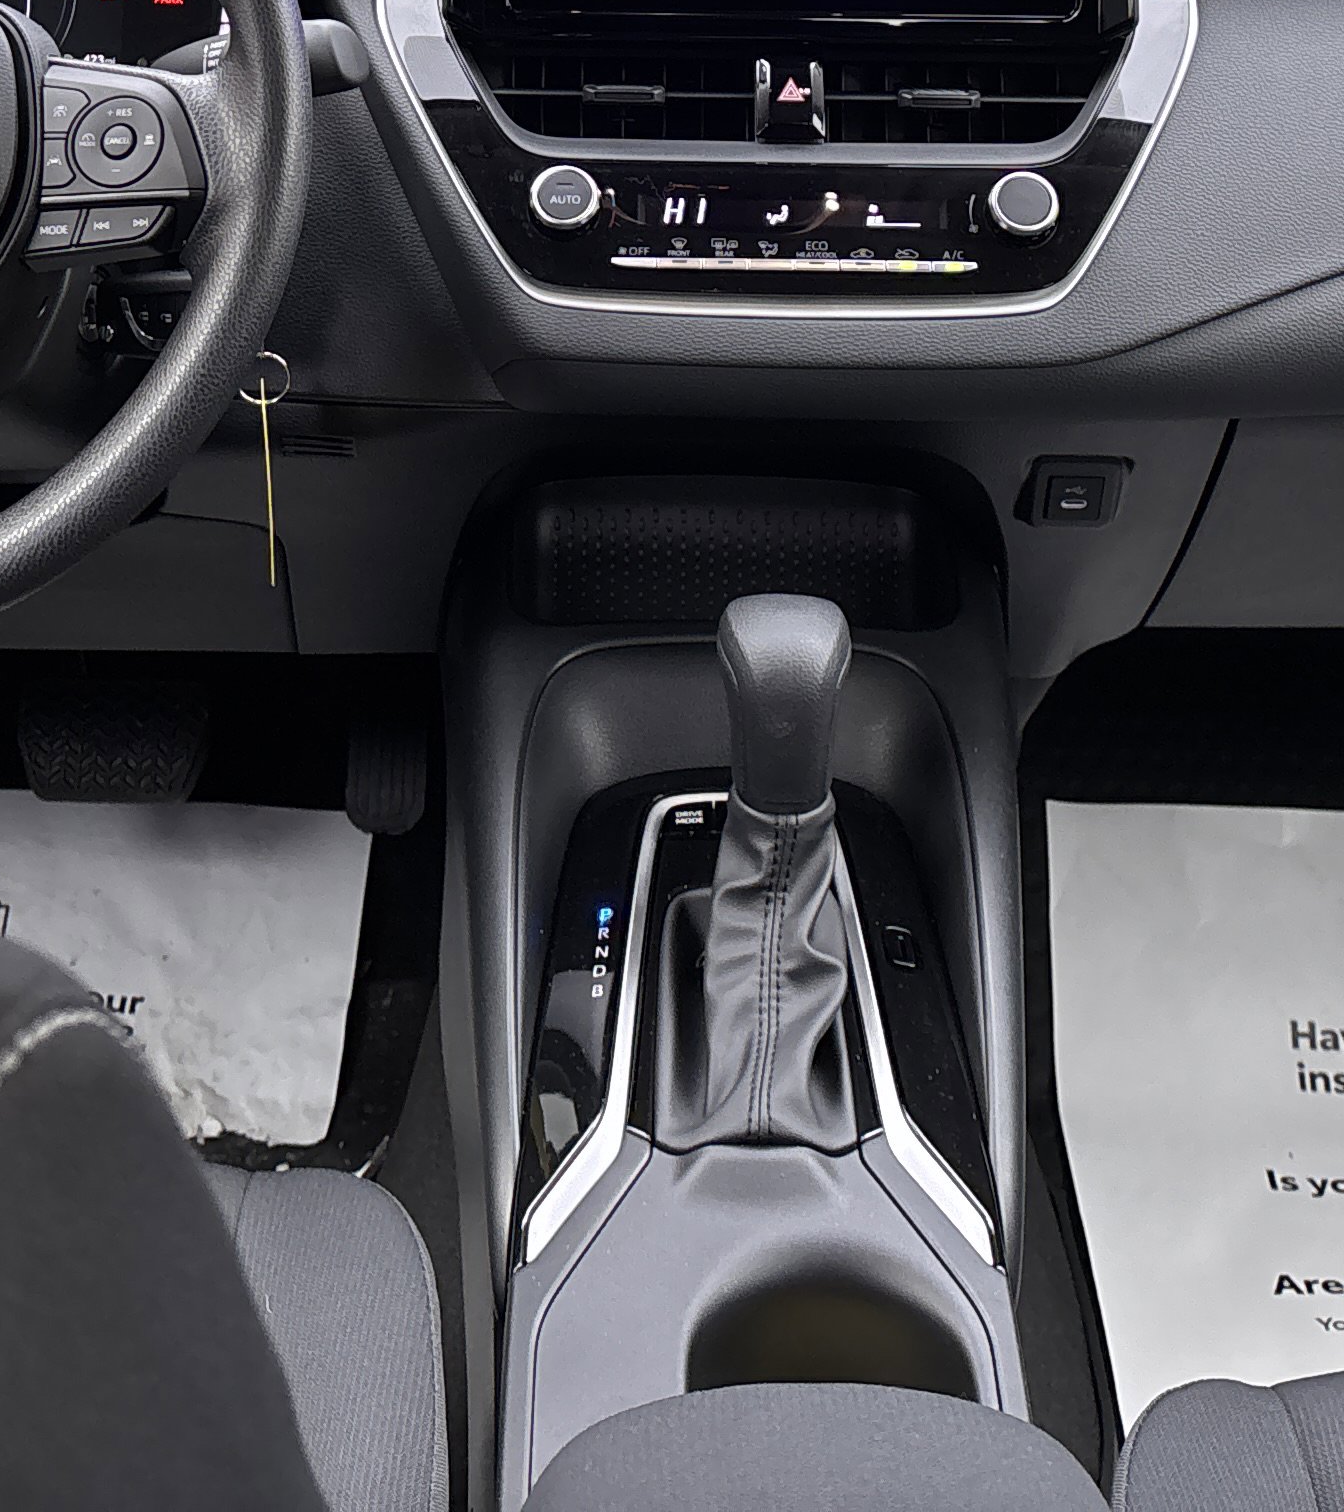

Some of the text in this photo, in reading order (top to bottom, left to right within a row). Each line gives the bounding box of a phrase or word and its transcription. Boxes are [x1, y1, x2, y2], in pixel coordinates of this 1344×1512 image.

[116, 108, 133, 116] RES
[105, 137, 130, 145] CANCEL
[549, 195, 581, 204] AUTO
[39, 225, 69, 236] MODE
[628, 246, 651, 255] OFF
[806, 241, 828, 251] ECO
[796, 251, 838, 259] HEAT/COOL
[943, 250, 964, 260] A/C
[675, 810, 703, 818] DRIVE
[598, 907, 613, 924] P
[598, 927, 609, 940] R
[594, 945, 609, 958] N
[592, 964, 606, 977] D
[591, 984, 604, 997] B
[1265, 1169, 1299, 1192] Is
[1273, 1274, 1344, 1296] Are
